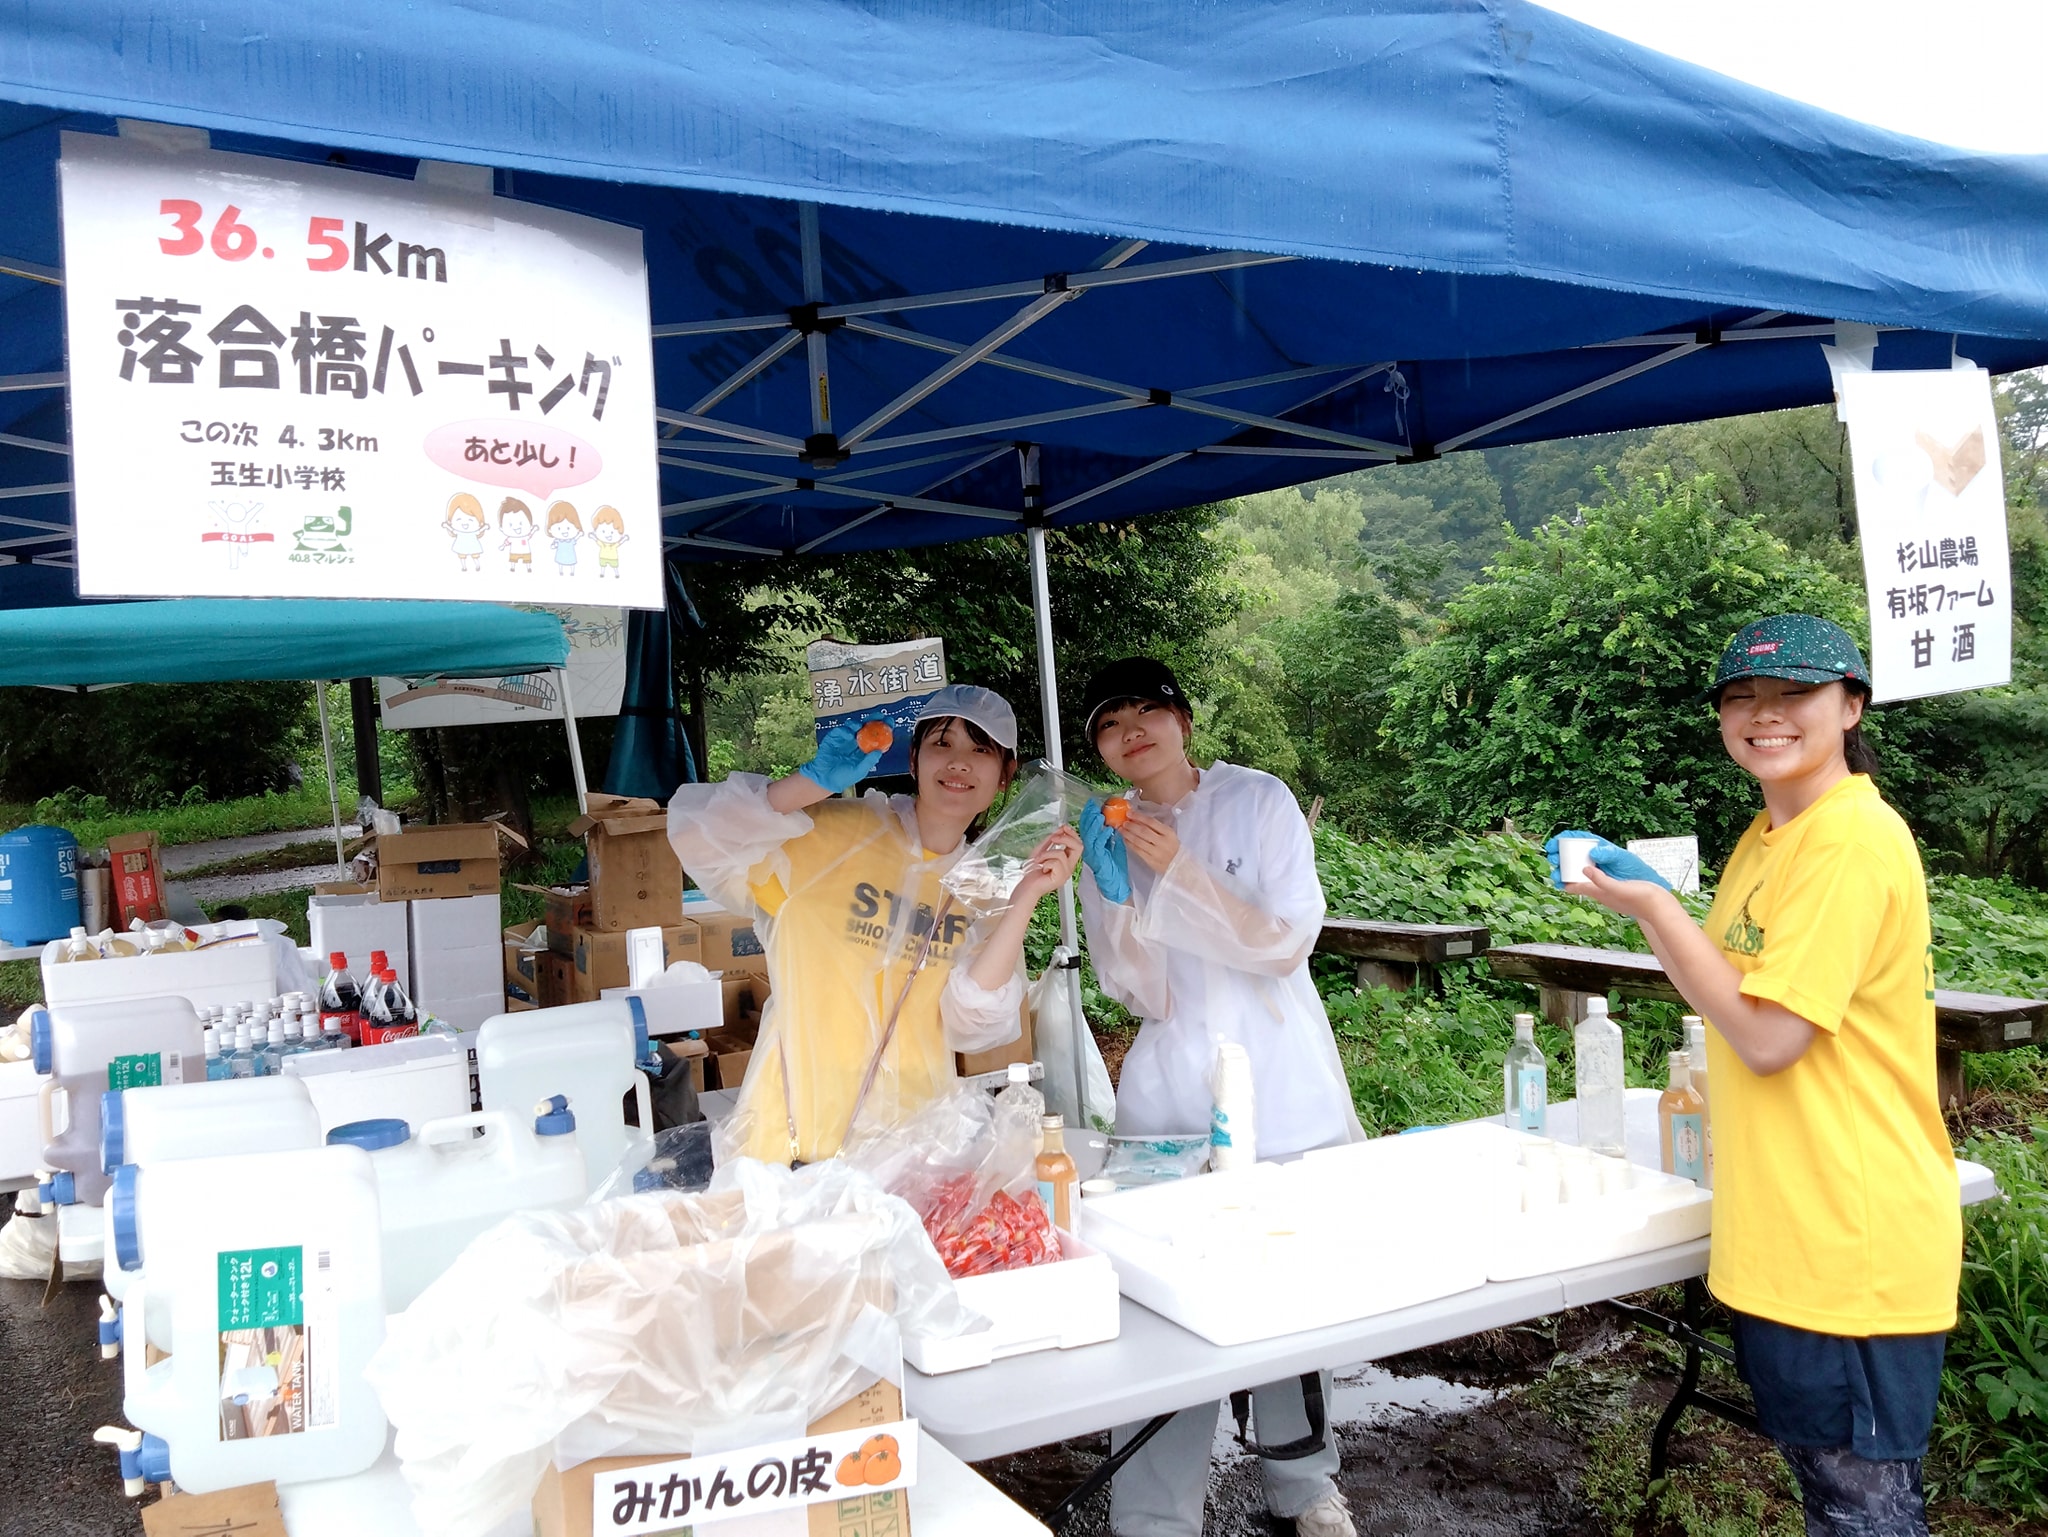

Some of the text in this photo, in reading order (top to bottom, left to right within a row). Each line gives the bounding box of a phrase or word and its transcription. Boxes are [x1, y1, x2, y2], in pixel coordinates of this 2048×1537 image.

[116, 297, 621, 422] 落合橋パーキング
[180, 420, 258, 447] この次
[211, 461, 346, 491] 玉生小学校
[221, 532, 254, 542] GOAL
[1897, 536, 1979, 573] 杉山農場
[1887, 580, 1994, 619] 有坂ファーム
[815, 653, 943, 709] 湧水街道
[291, 1360, 304, 1430] WATER TANK
[612, 1447, 832, 1526] みかんの皮
